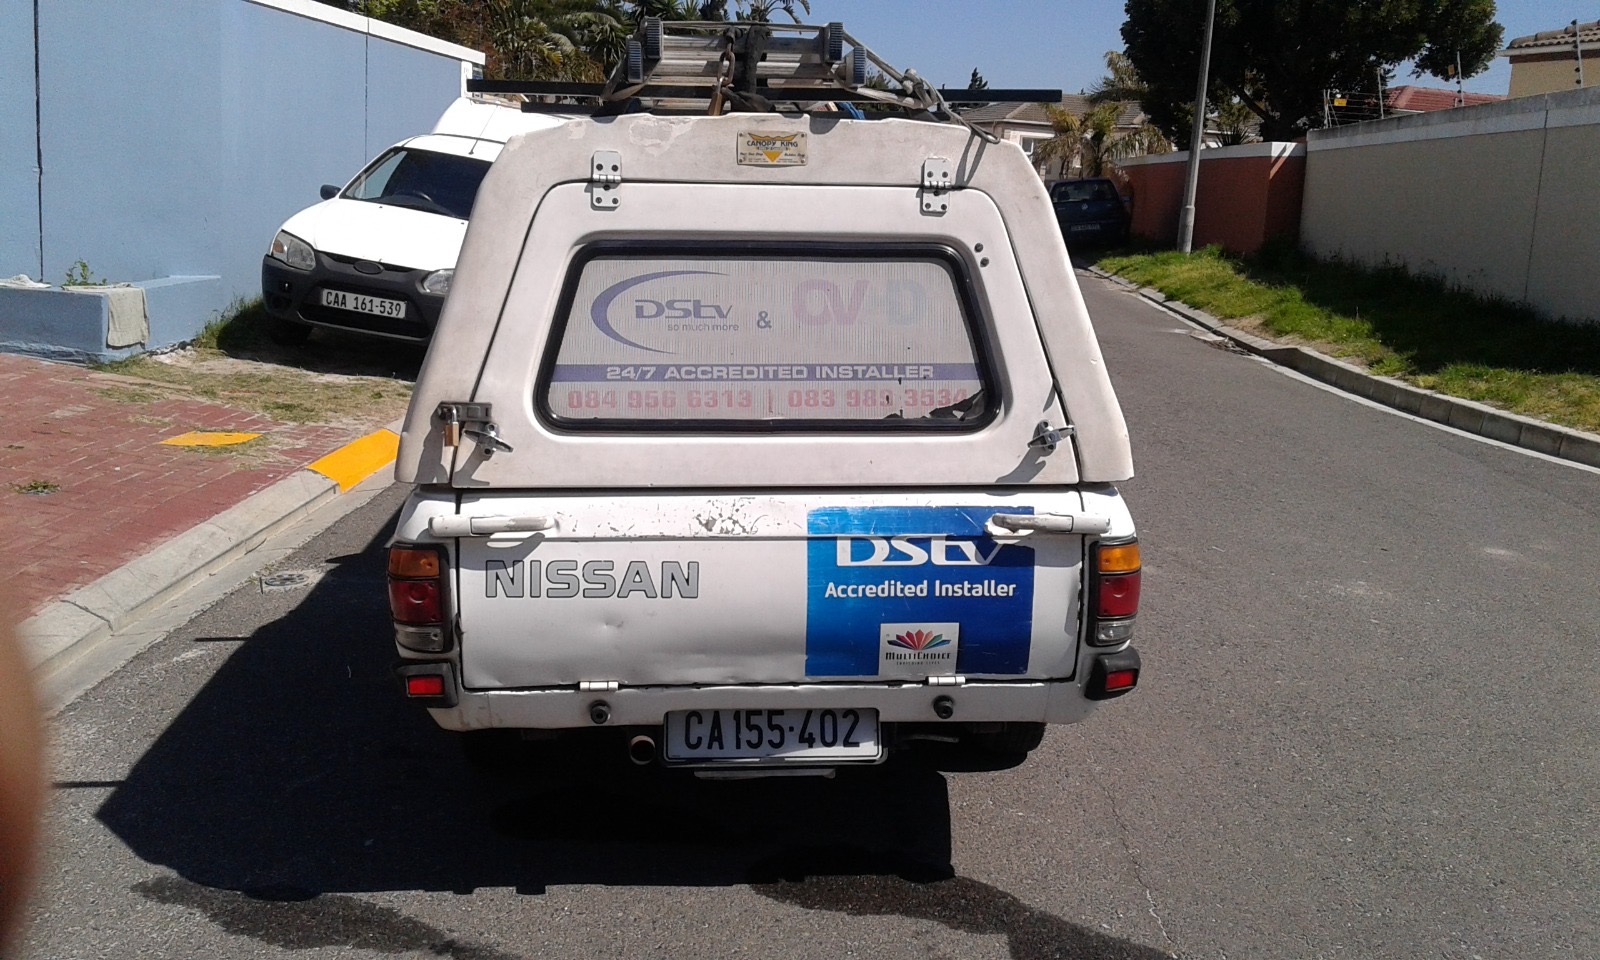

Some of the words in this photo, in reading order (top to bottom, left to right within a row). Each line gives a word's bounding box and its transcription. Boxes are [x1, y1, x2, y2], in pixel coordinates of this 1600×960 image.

[781, 140, 798, 148] KING
[326, 291, 347, 308] CAA
[353, 296, 402, 316] 161-539
[635, 300, 732, 319] DStv
[667, 323, 679, 331] so
[682, 321, 710, 331] much
[712, 323, 739, 331] more
[757, 311, 772, 329] &
[606, 366, 656, 380] 24/7
[664, 365, 808, 379] ACCREDITED
[815, 365, 934, 379] INSTALLER
[568, 390, 616, 408] 084
[628, 390, 676, 408] 956
[687, 390, 752, 408] 6313
[788, 389, 835, 407] 083
[836, 534, 1021, 566] DStv
[485, 559, 699, 598] NISSAN
[825, 580, 928, 598] Accredited
[935, 580, 1017, 597] Installer
